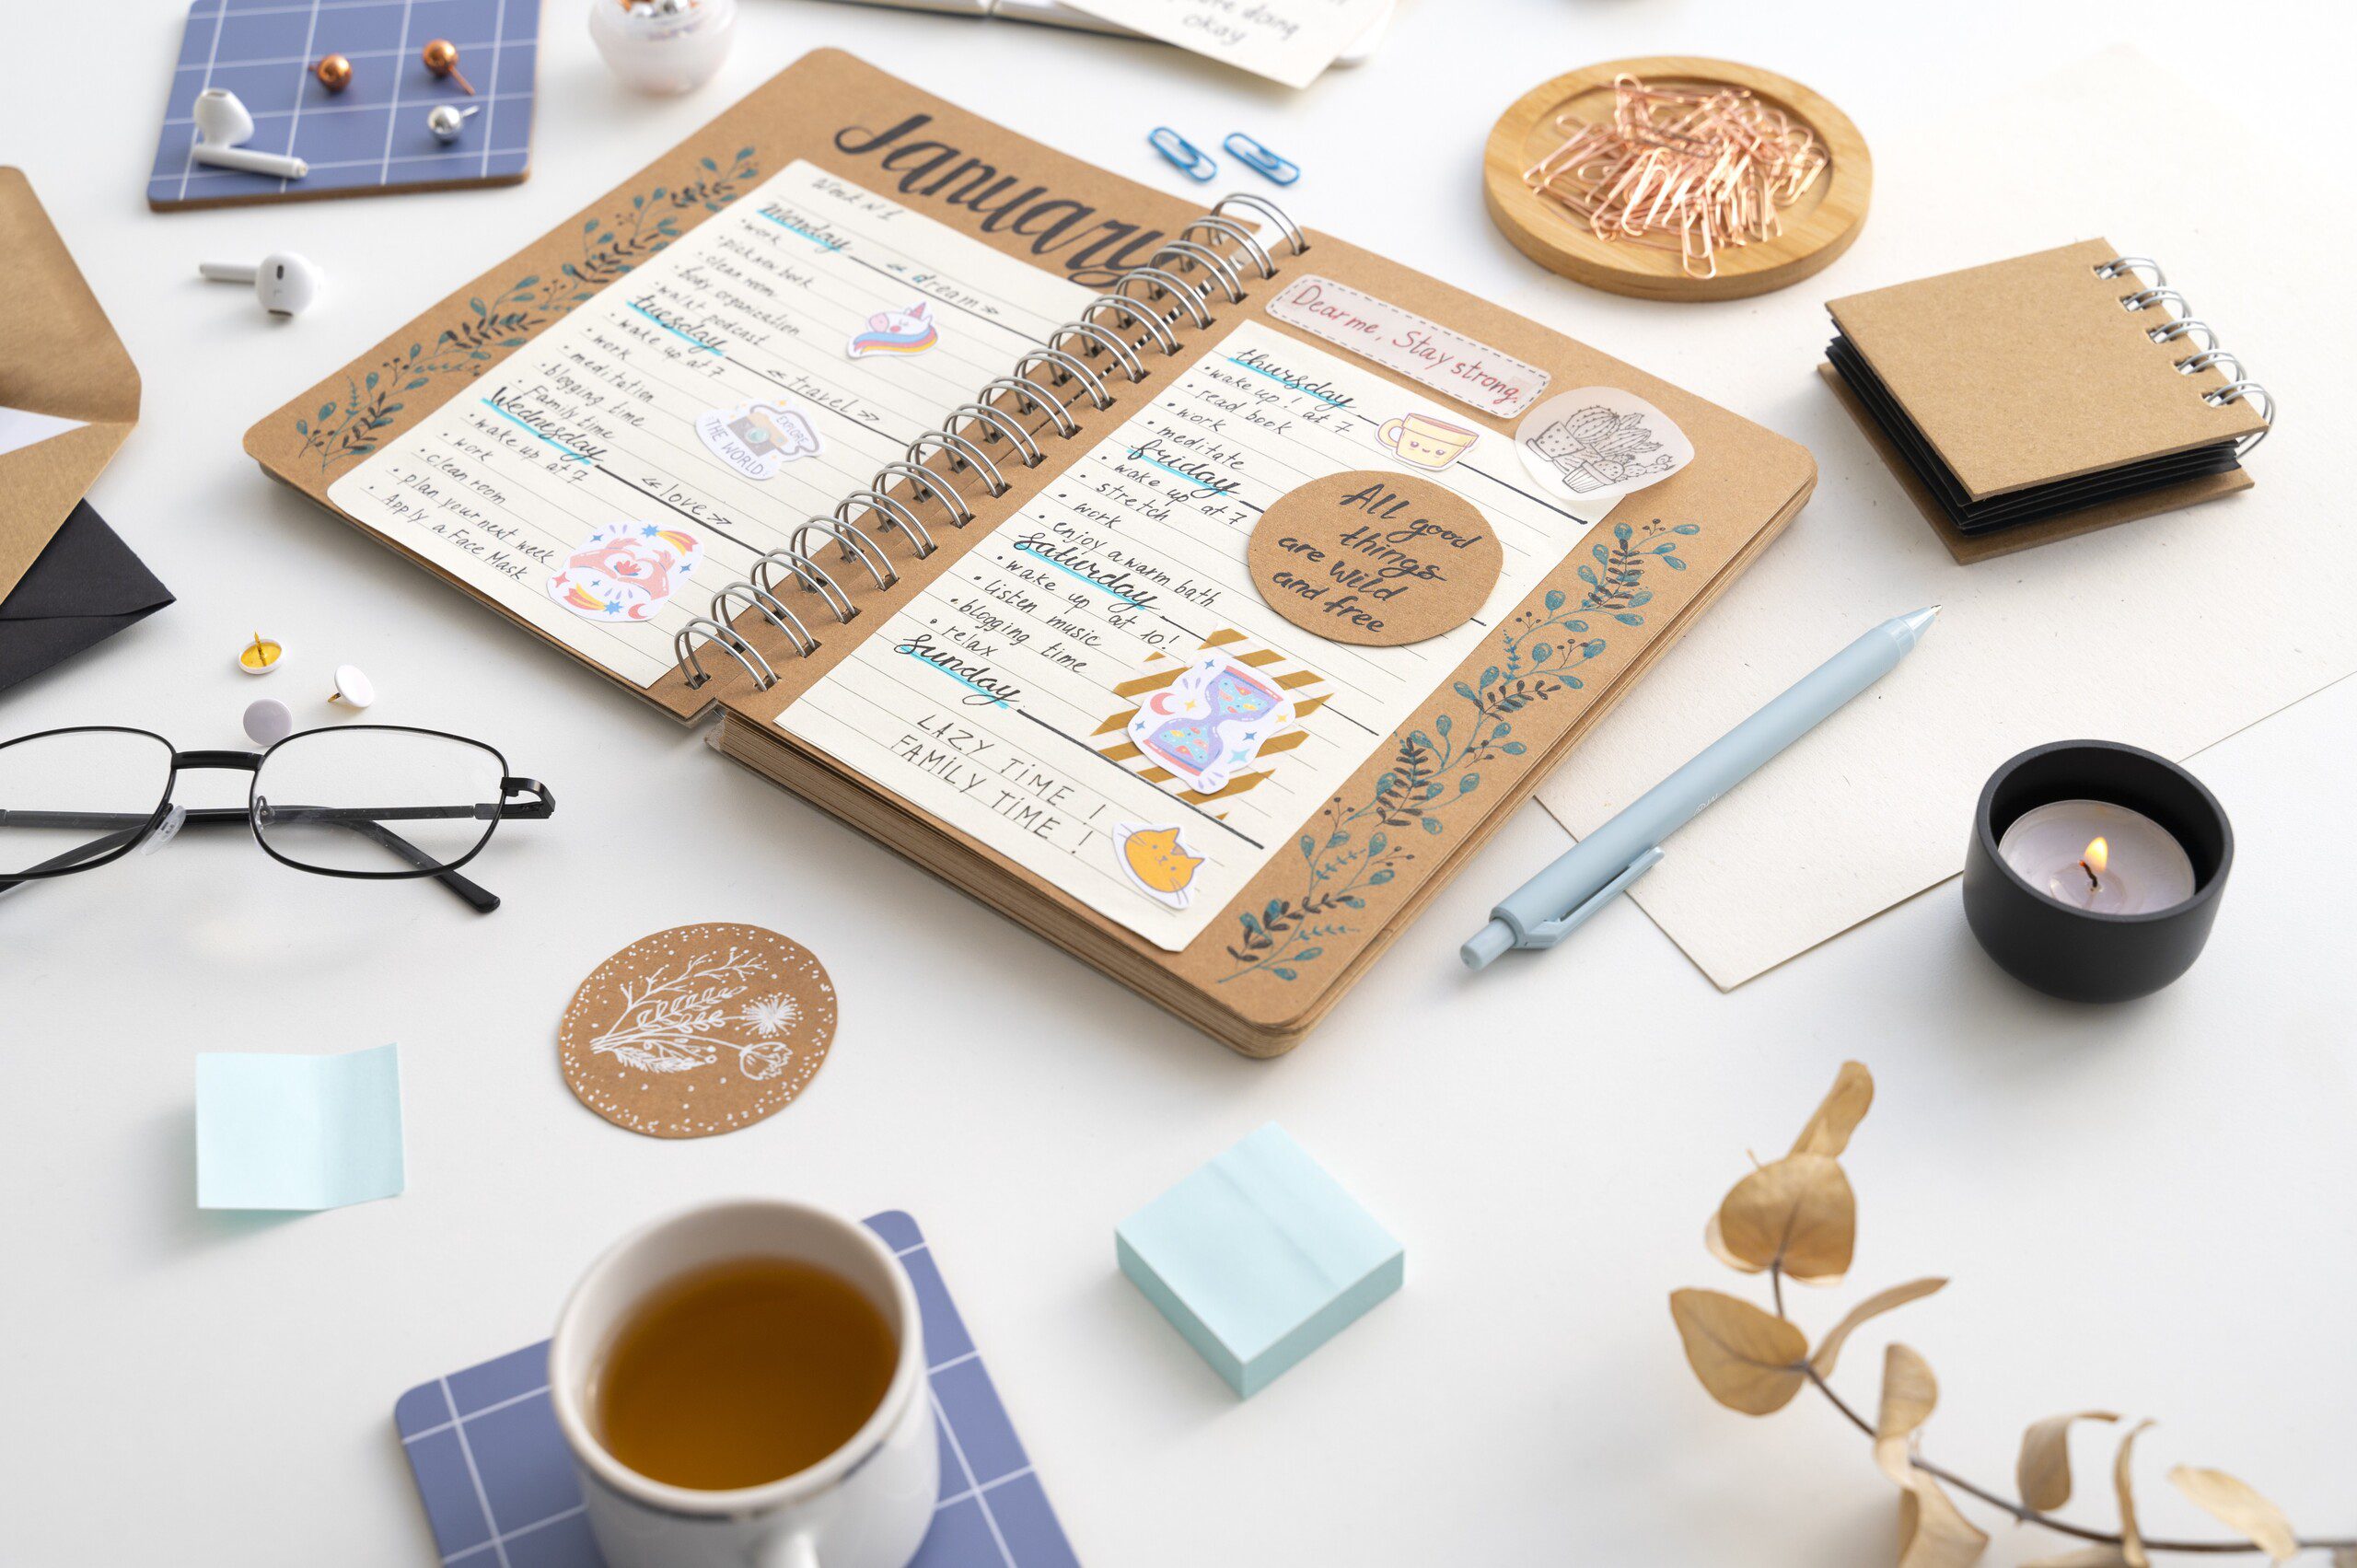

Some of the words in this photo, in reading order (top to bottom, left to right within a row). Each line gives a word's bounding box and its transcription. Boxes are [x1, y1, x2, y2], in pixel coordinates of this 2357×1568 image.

[834, 114, 1183, 287] January
[744, 222, 780, 246] work
[911, 272, 978, 309] dream
[593, 334, 633, 361] work
[619, 320, 661, 346] wake
[664, 345, 681, 361] up
[687, 358, 711, 372] at
[707, 366, 726, 378] 7
[1292, 285, 1345, 320] Dear
[1393, 331, 1454, 369] Stay
[545, 364, 604, 407] blogging
[609, 402, 644, 427] time
[788, 373, 851, 414] travel
[1177, 408, 1225, 432] work
[1194, 389, 1245, 413] read
[1245, 408, 1292, 435] book
[1211, 370, 1252, 391] wake
[1304, 412, 1329, 424] at
[1336, 420, 1354, 433] 7
[454, 438, 493, 461] work
[475, 418, 517, 447] wake
[519, 446, 540, 460] up
[546, 461, 567, 476] at
[567, 470, 588, 483] 7
[491, 387, 607, 461] Wednesday
[577, 415, 614, 439] time
[705, 419, 728, 441] THE
[722, 442, 763, 475] WORLD
[1157, 426, 1244, 470] meditate
[427, 453, 467, 482] clean
[470, 479, 505, 504] room
[660, 483, 707, 517] love
[1097, 482, 1168, 521] stretch
[1114, 463, 1161, 486] wake
[1167, 489, 1190, 505] up
[1201, 504, 1225, 518] at
[1229, 512, 1248, 525] 7
[384, 494, 429, 522] Apply
[433, 523, 447, 533] a
[449, 528, 485, 556] Face
[487, 552, 527, 580] Mask
[398, 472, 438, 502] plan
[437, 497, 481, 522] your
[478, 519, 516, 540] next
[518, 540, 552, 563] week
[1074, 504, 1120, 528] work
[1340, 483, 1410, 518] All
[1386, 518, 1482, 549] good
[1053, 522, 1108, 554] enjoy
[1109, 550, 1123, 561] a
[1125, 557, 1170, 587] warm
[1174, 580, 1221, 608] bath
[1278, 537, 1326, 563] are
[1340, 526, 1447, 581] things
[984, 580, 1039, 612] listen
[1046, 615, 1102, 646] music
[1006, 559, 1055, 591] wake
[1068, 593, 1092, 614] up
[1108, 614, 1136, 629] at
[1141, 632, 1180, 650] 10!
[1272, 570, 1329, 601] and
[1323, 596, 1385, 633] free
[941, 625, 999, 656] relax
[959, 599, 1030, 645] blogging
[1040, 642, 1087, 674] time
[917, 714, 994, 755] LAZY
